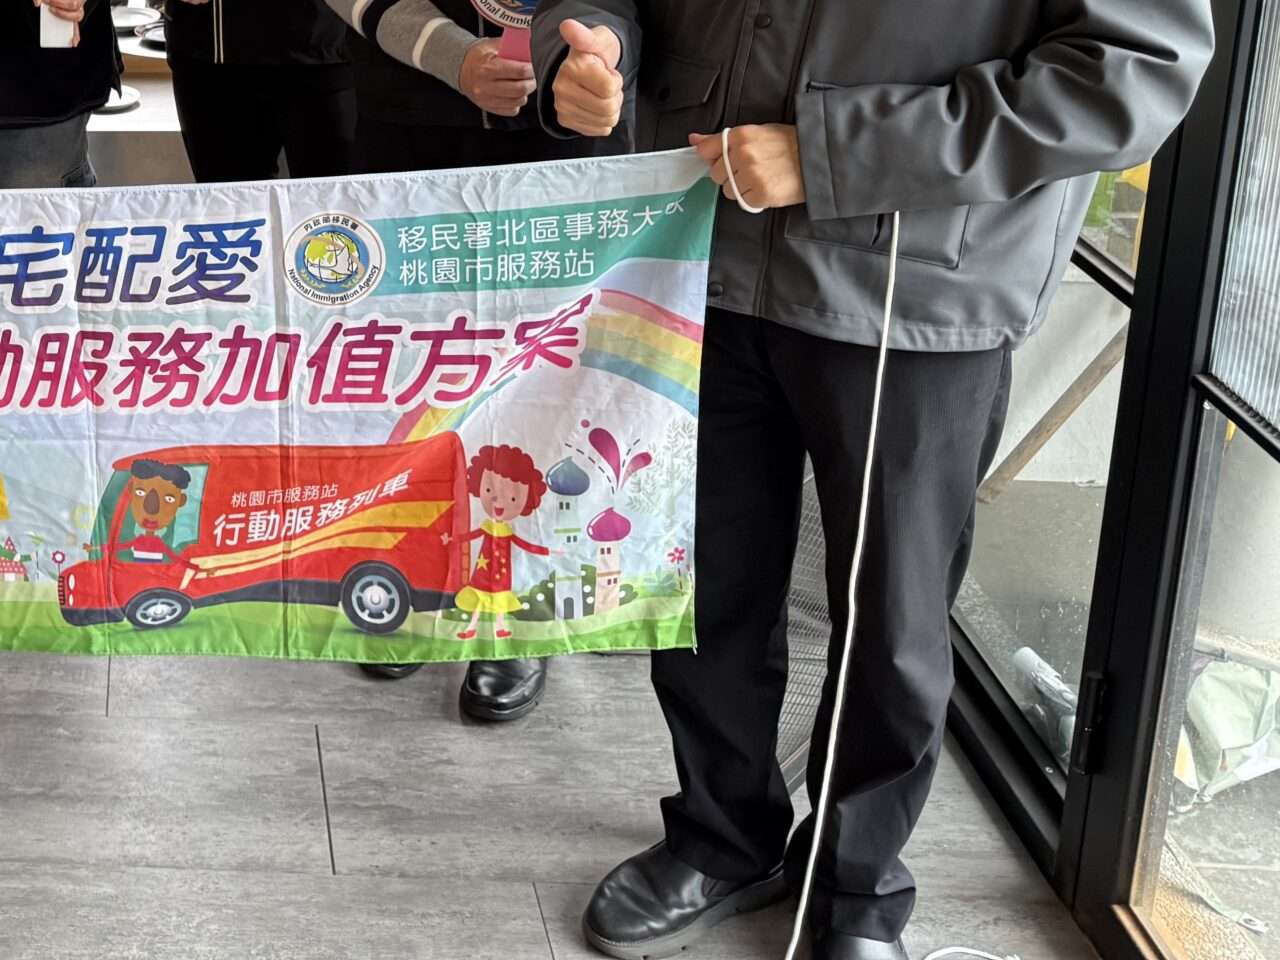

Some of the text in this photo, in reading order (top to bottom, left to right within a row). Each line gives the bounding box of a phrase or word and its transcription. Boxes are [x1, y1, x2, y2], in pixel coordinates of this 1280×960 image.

[397, 196, 685, 254] 移民署北區事務大
[399, 248, 595, 287] 桃園市服務站
[213, 468, 413, 547] 行動服務列車
[230, 483, 339, 508] 桃園市服務站
